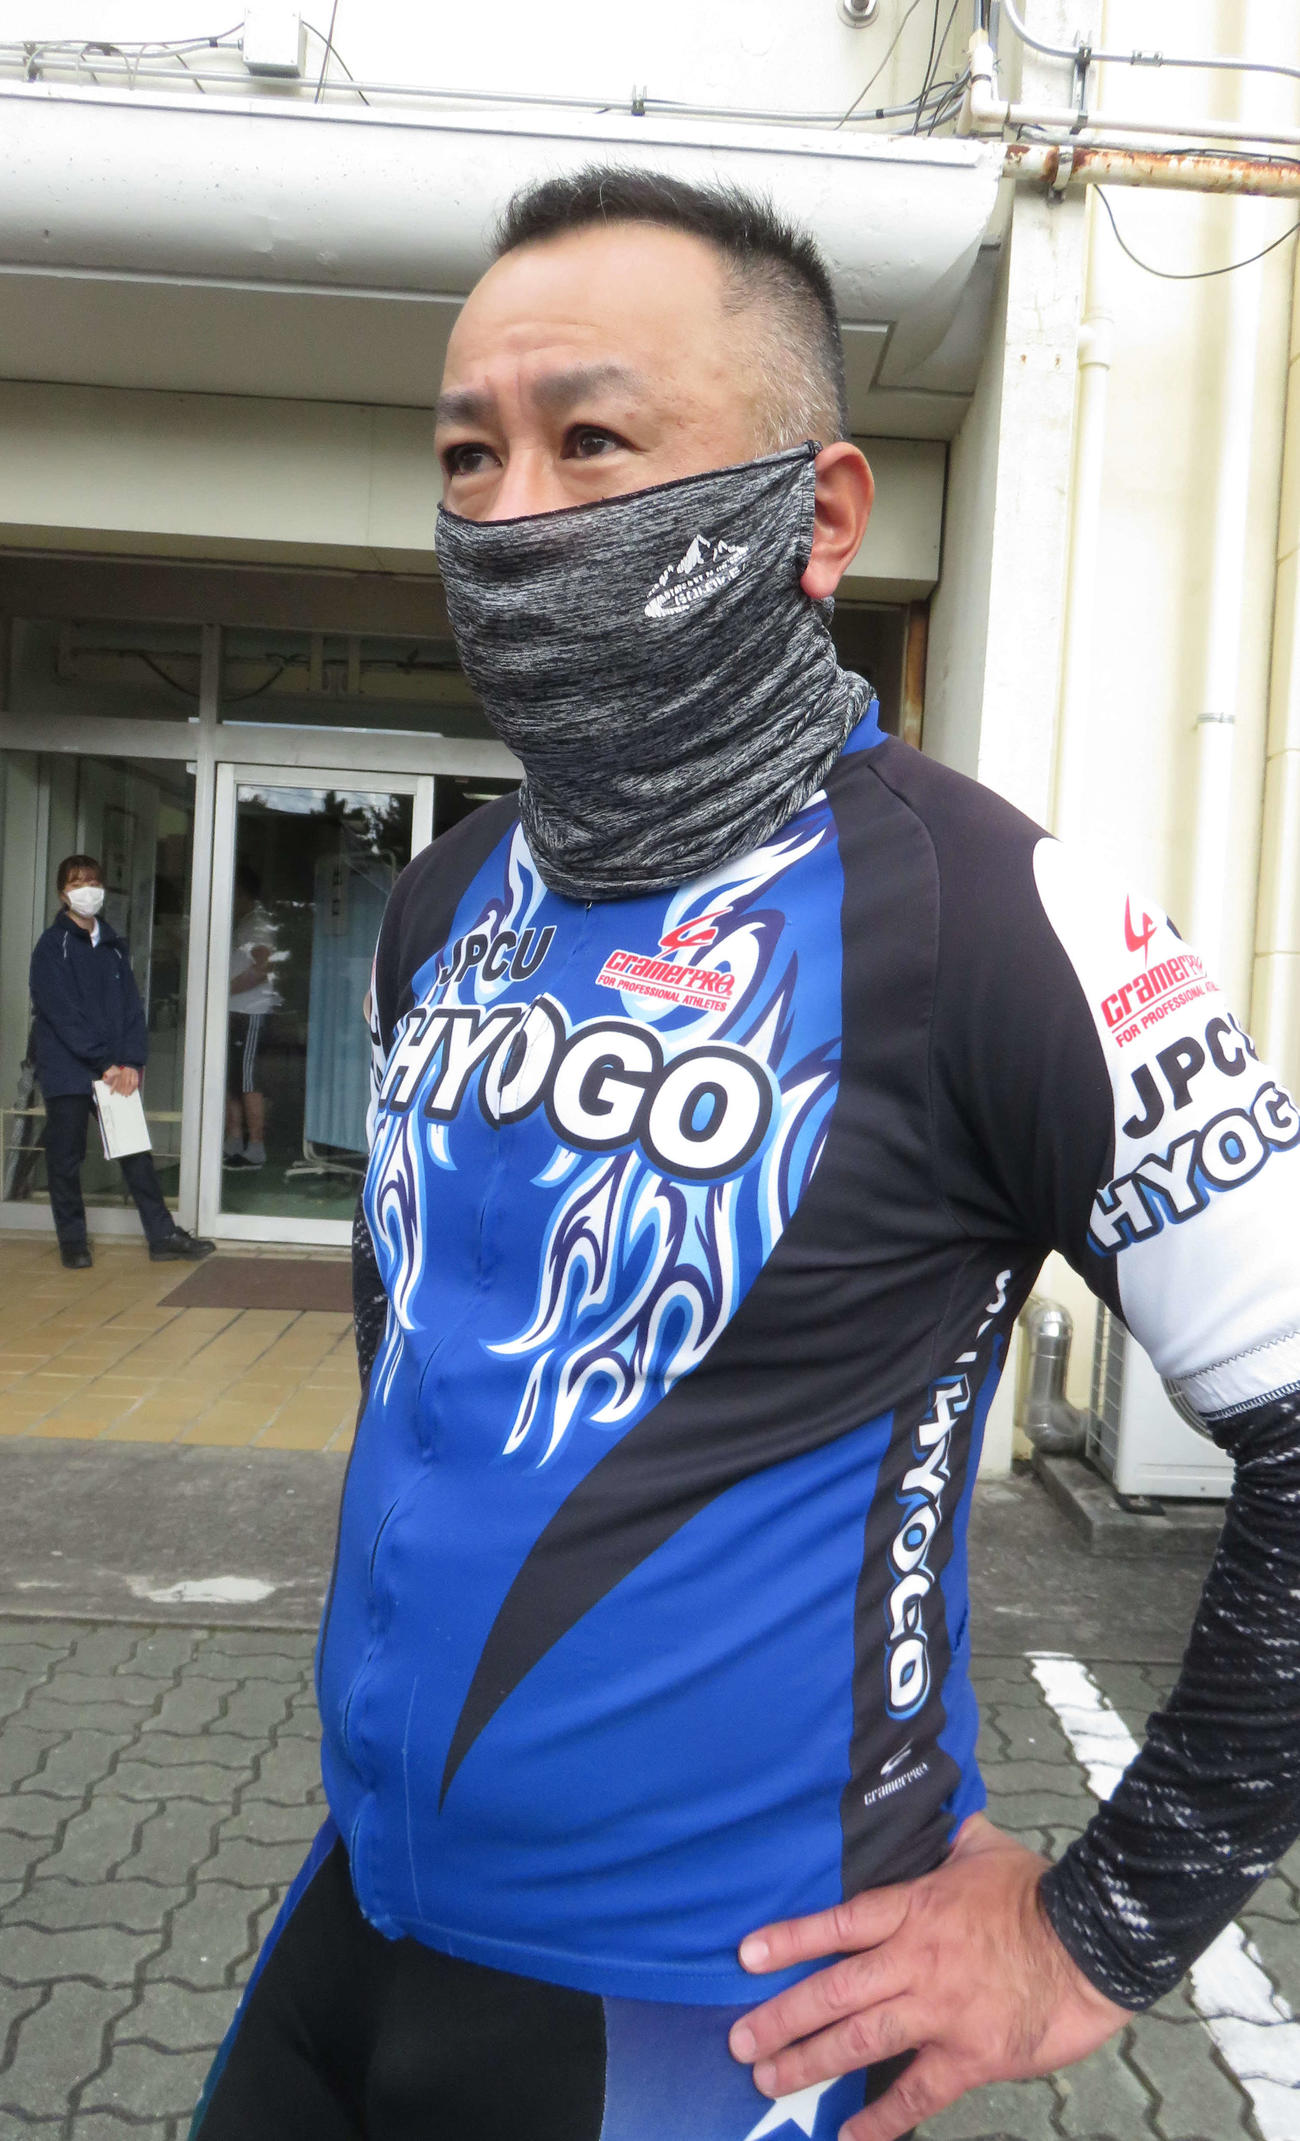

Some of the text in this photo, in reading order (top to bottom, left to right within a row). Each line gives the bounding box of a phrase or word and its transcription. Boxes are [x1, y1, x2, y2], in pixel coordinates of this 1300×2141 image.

[438, 925, 556, 985] JPCU
[598, 974, 727, 1012] FOR PROFESSIONAL ATHLETES
[1115, 984, 1206, 1048] FOR PROFESSIONAL
[378, 996, 773, 1181] HYOGO
